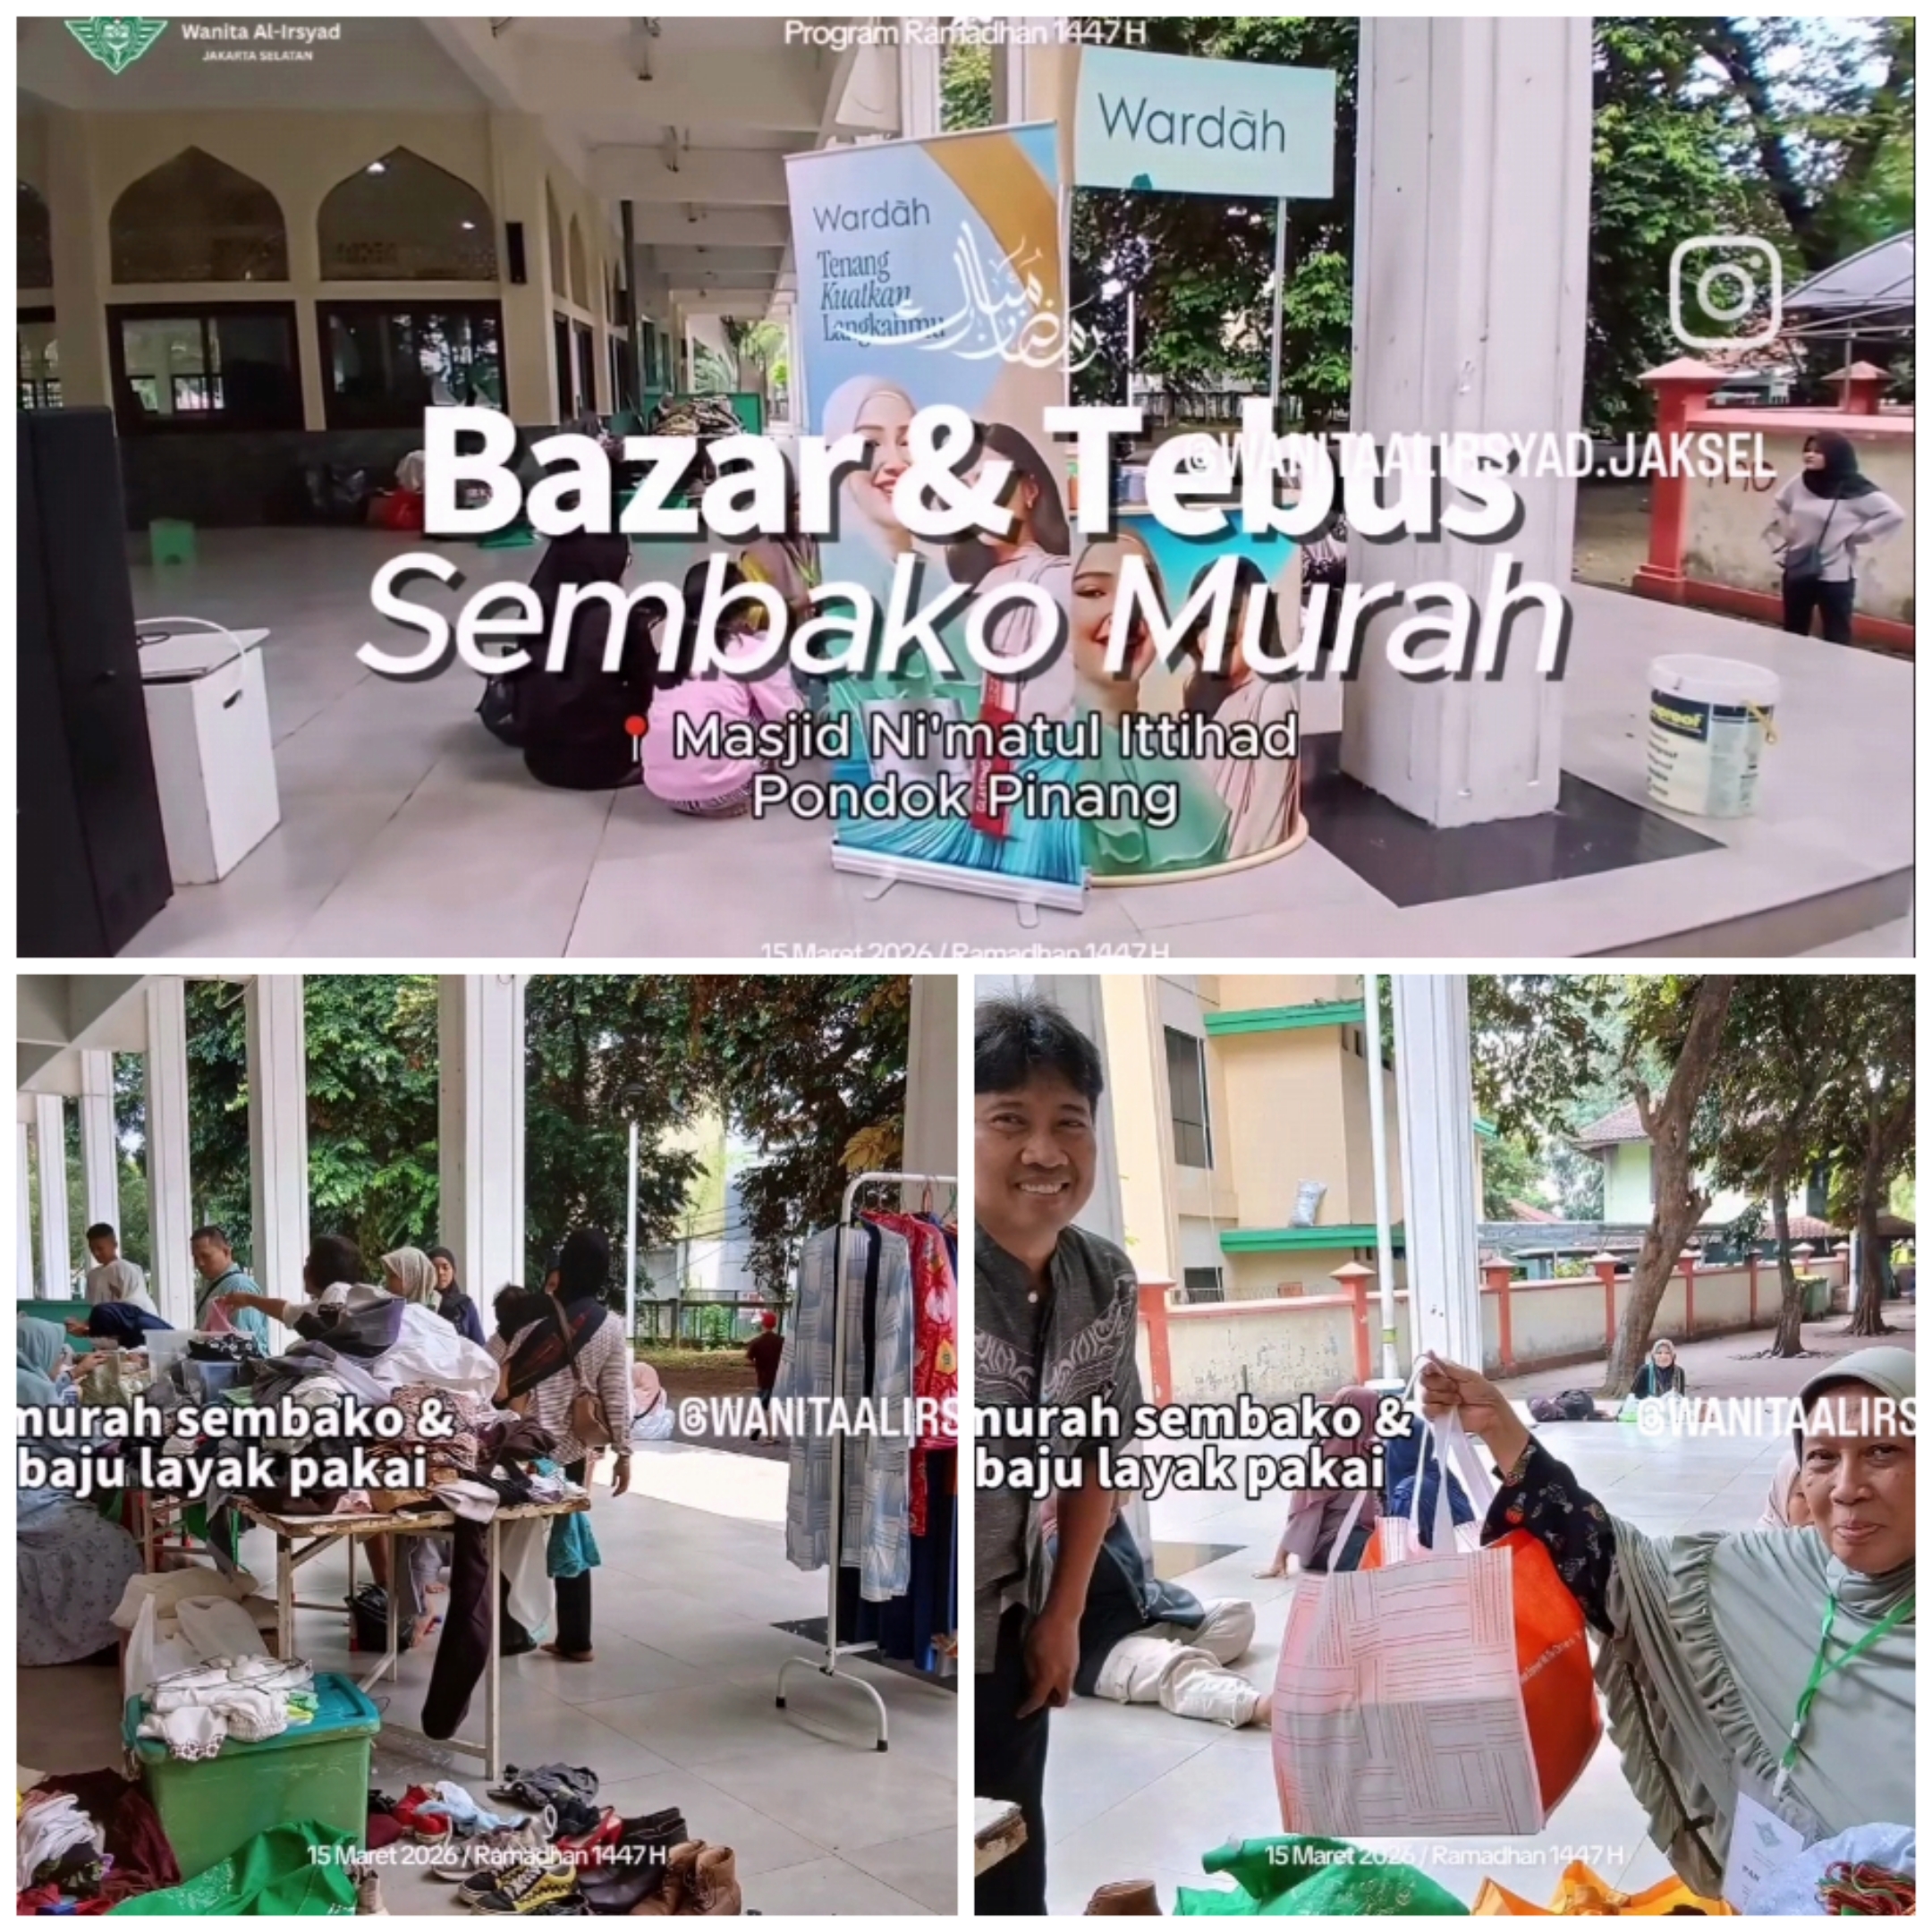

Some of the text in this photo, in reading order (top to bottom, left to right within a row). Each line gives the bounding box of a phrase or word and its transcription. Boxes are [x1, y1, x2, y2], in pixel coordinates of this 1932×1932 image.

[818, 250, 892, 284] Tenang
[820, 283, 913, 310] Kuatkan
[823, 309, 947, 347] Langkahmu
